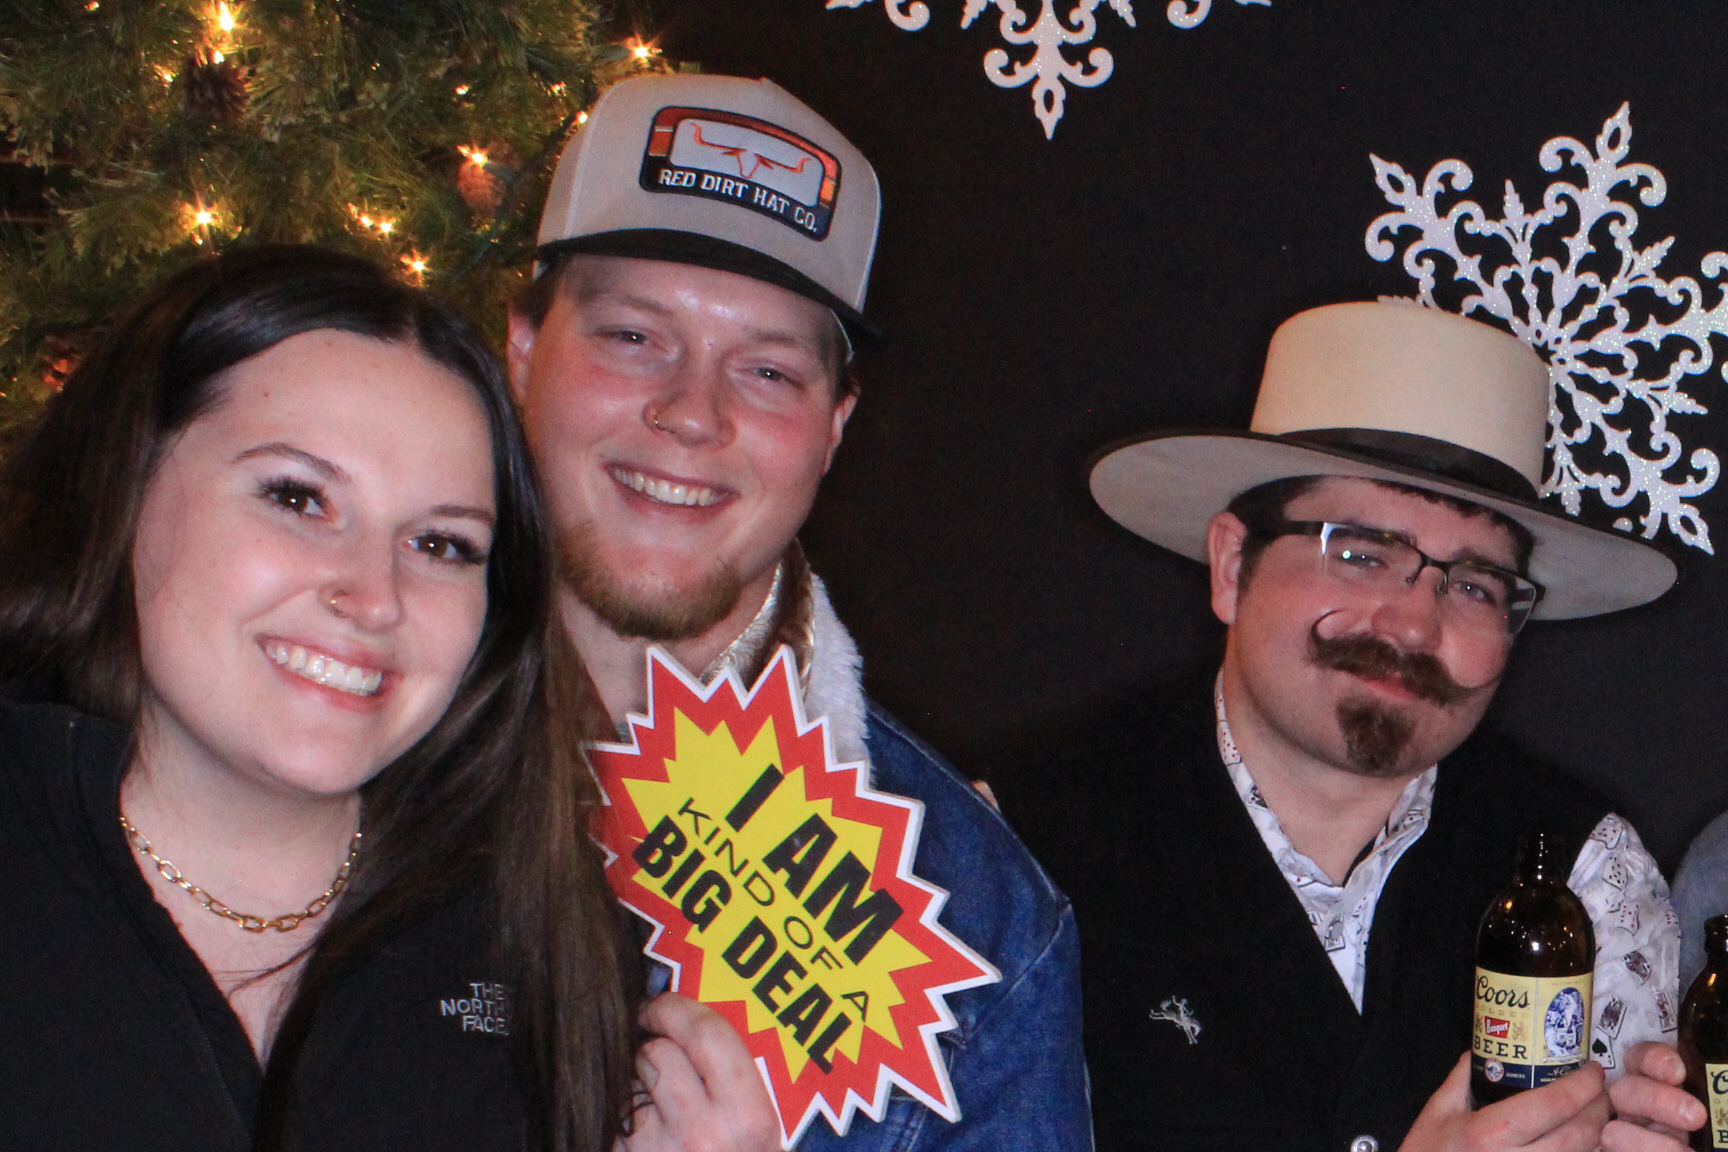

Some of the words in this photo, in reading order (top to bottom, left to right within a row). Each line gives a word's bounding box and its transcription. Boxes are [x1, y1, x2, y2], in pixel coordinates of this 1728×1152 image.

[659, 169, 696, 188] RED
[701, 175, 749, 199] DIRT
[754, 187, 790, 214] HAT
[794, 206, 818, 232] CO.
[725, 763, 785, 833] I
[762, 813, 904, 966] AM
[678, 797, 776, 907] KIND
[783, 915, 843, 970] OF
[842, 990, 870, 1022] A
[631, 815, 733, 933] BIG
[721, 916, 853, 1075] DEAL
[469, 982, 505, 1000] THE
[1477, 975, 1530, 1009] Coors
[440, 998, 506, 1016] NORTH
[462, 1014, 506, 1034] FACE
[1486, 1018, 1508, 1035] Banquet
[1473, 1034, 1528, 1060] BEER
